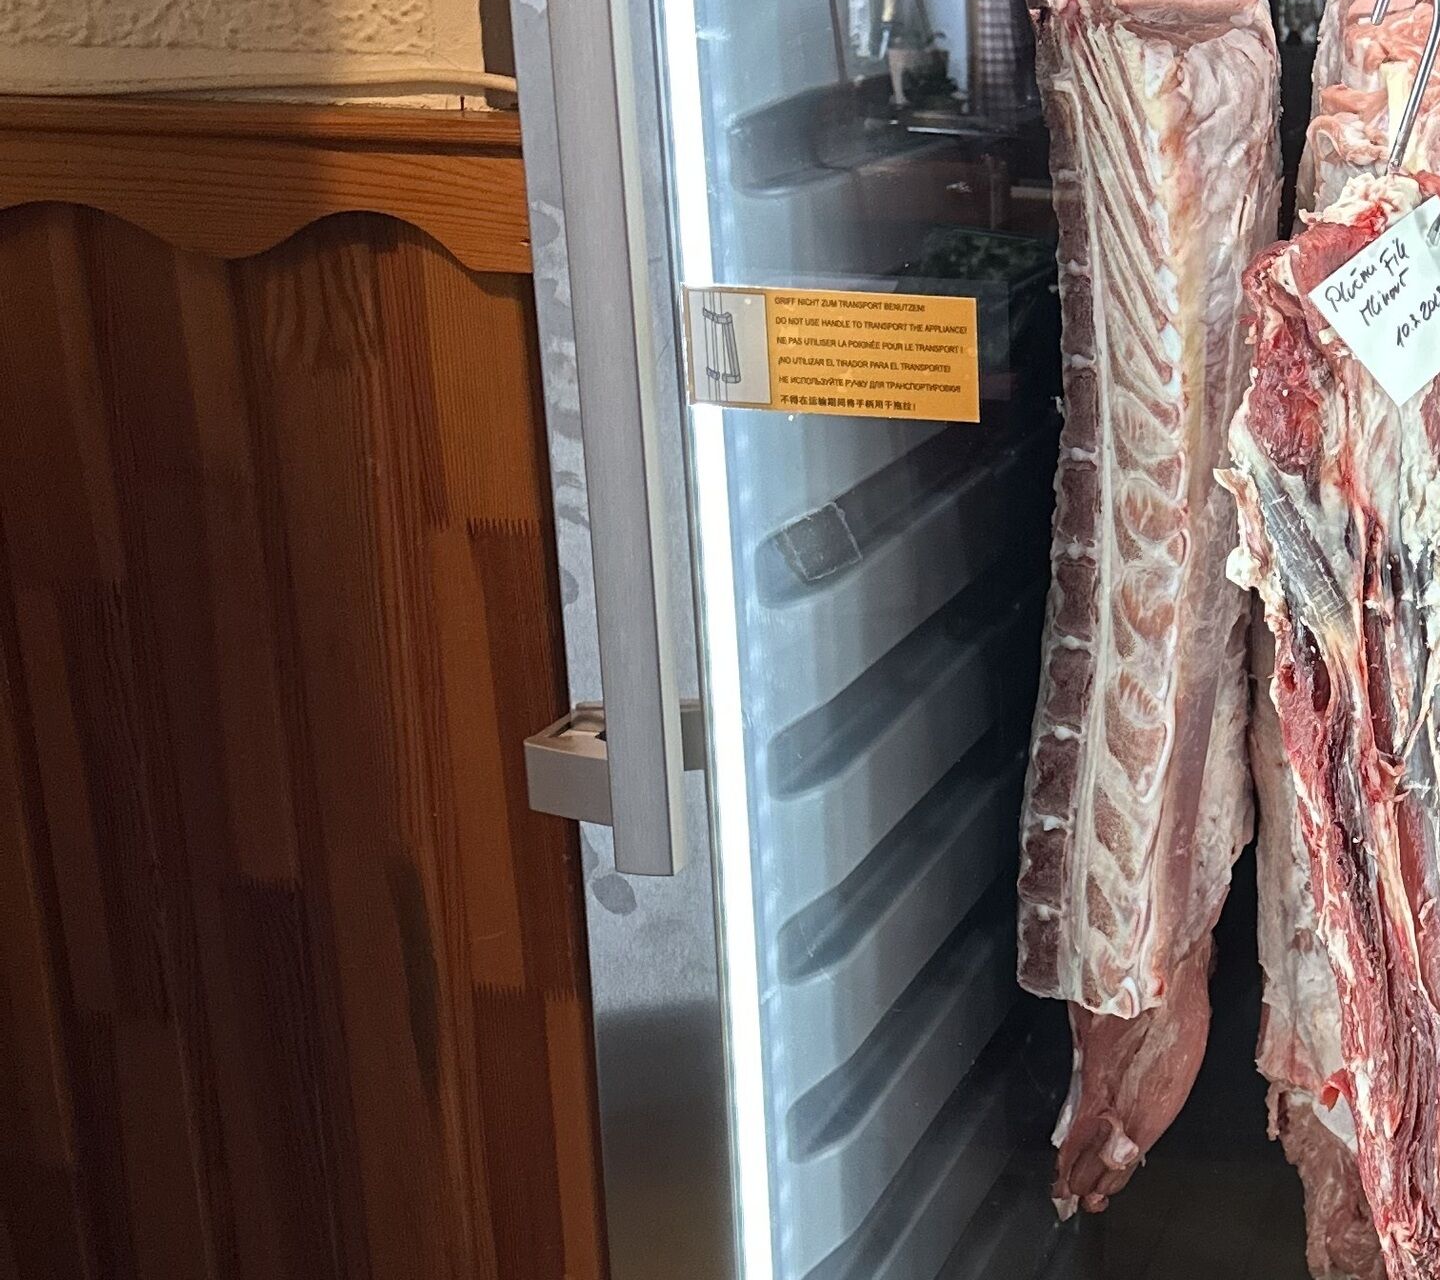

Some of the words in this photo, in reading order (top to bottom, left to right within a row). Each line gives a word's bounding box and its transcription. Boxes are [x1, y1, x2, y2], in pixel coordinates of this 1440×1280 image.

[798, 298, 820, 306] NICHT
[821, 299, 837, 307] ZUM
[839, 300, 882, 309] TRANSPORT
[788, 317, 803, 325] NOT
[805, 318, 819, 326] USE
[821, 319, 850, 328] HANDLE
[865, 321, 907, 331] TRANSPORT
[909, 324, 923, 332] THE
[788, 337, 802, 345] PAS
[804, 338, 836, 347] UTILISER
[838, 340, 847, 348] LA
[882, 342, 903, 351] POUR
[904, 343, 913, 351] LE
[916, 344, 959, 354] TRANSPORT
[793, 357, 824, 366] UTILIZAR
[837, 359, 868, 368] TIRADOR
[870, 361, 888, 369] PARA
[891, 362, 899, 370] EL
[779, 376, 788, 384] НЕ
